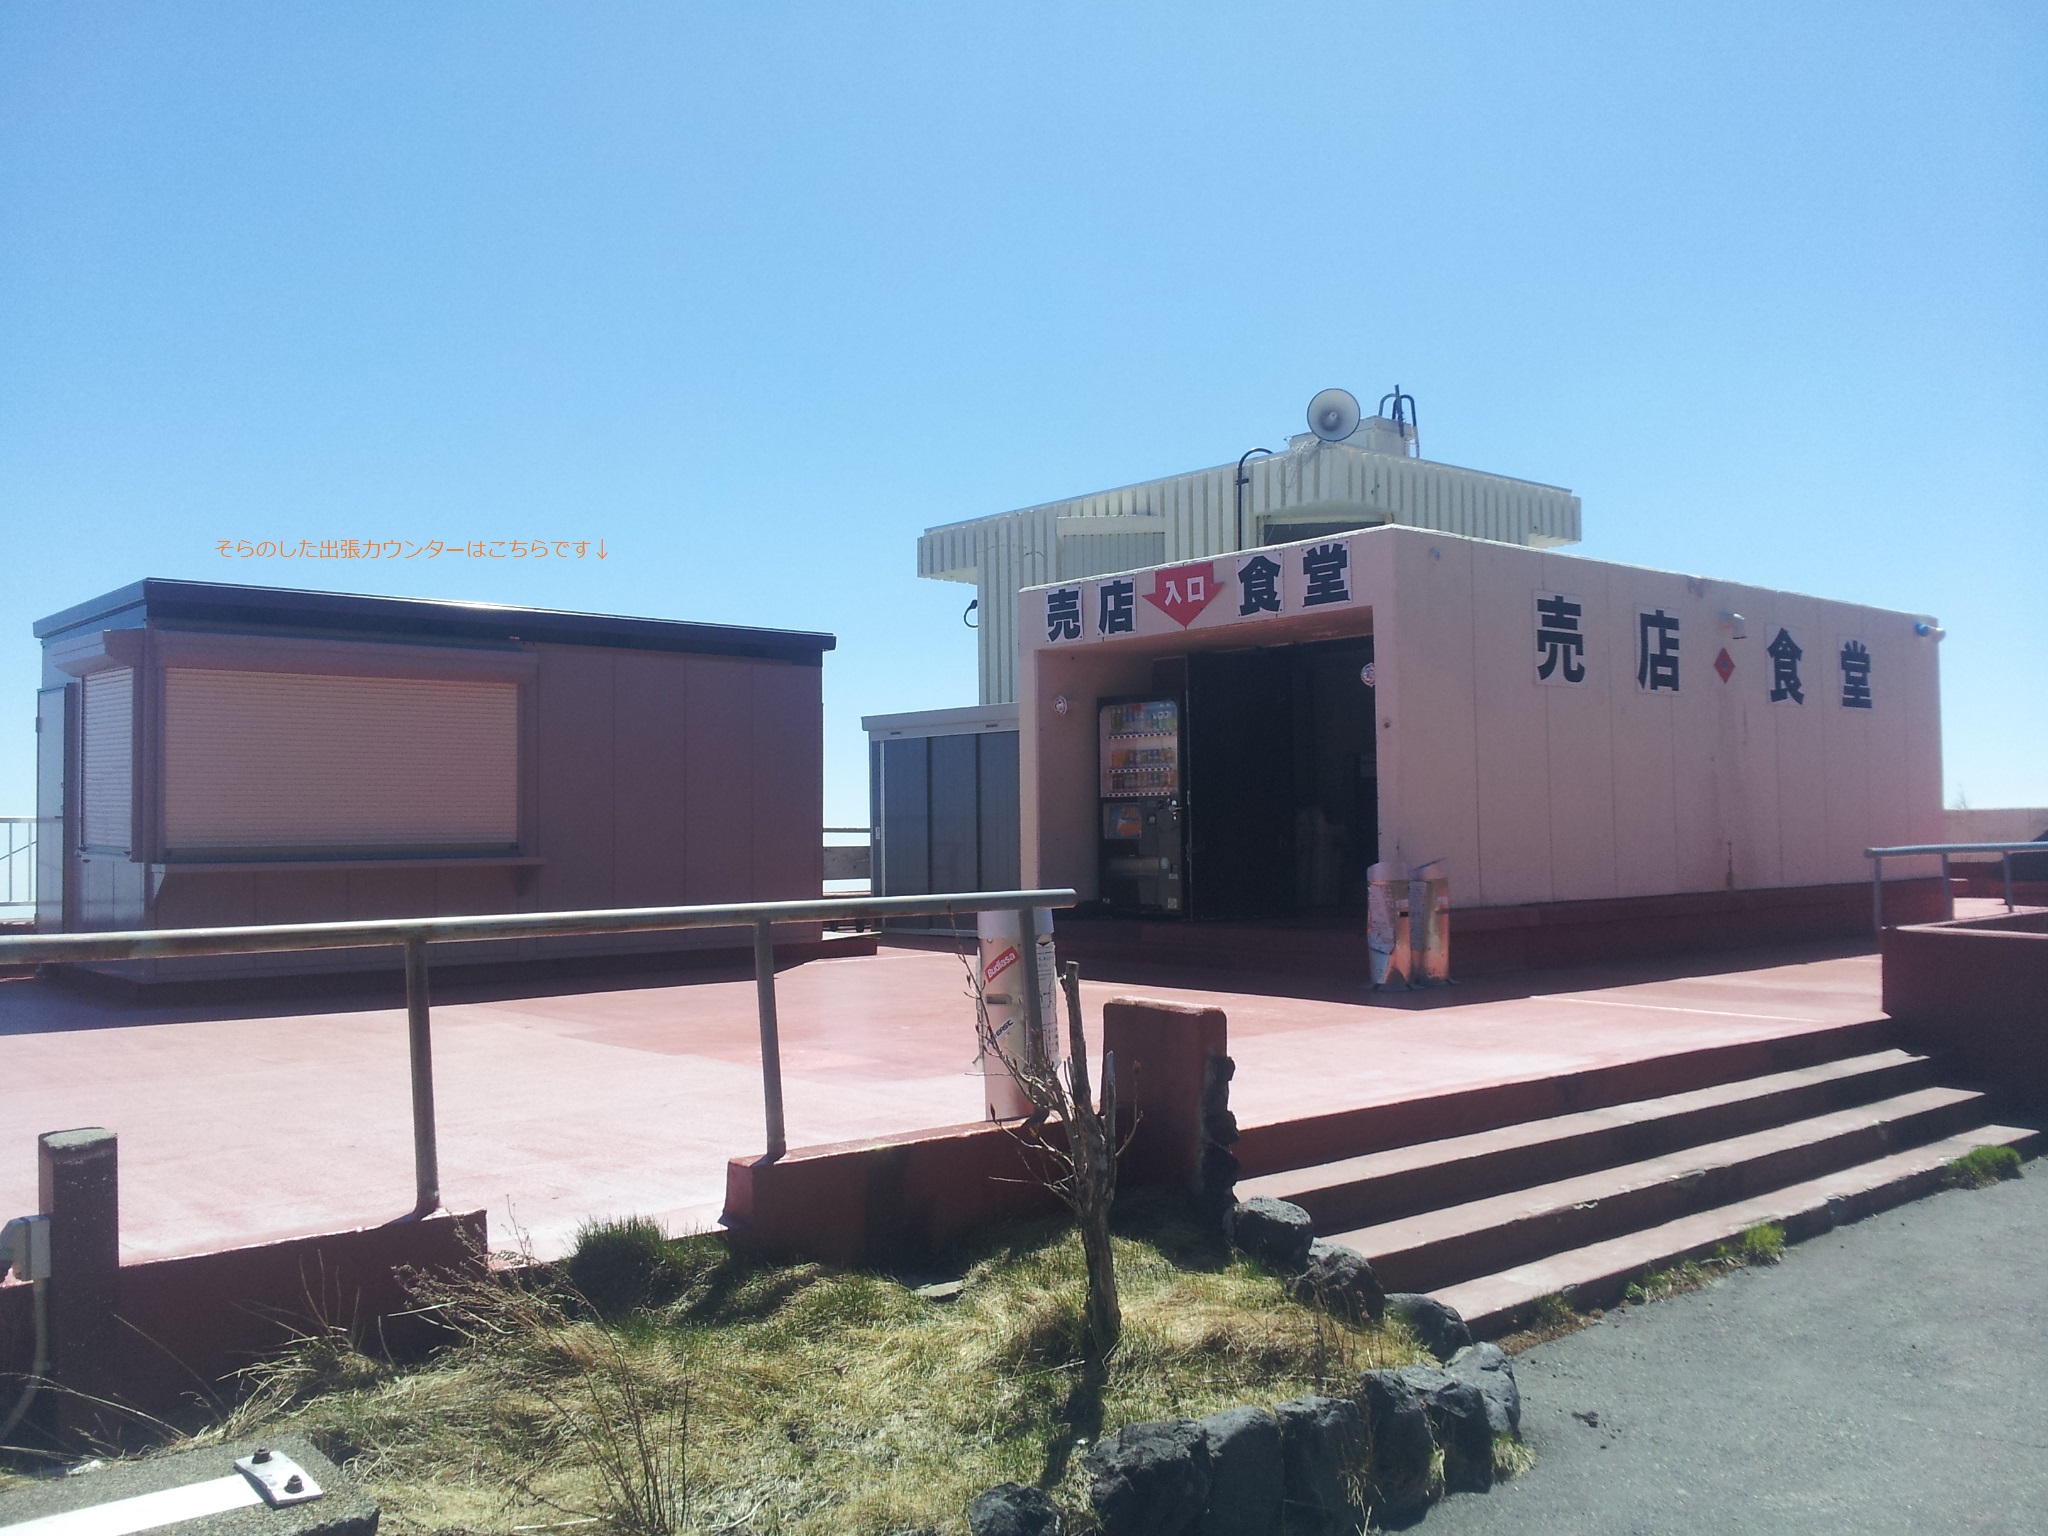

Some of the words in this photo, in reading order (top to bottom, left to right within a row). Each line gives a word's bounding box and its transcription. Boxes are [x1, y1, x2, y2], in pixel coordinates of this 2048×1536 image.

[1046, 580, 1135, 642] 売店
[1164, 576, 1205, 606] 入口
[1237, 543, 1350, 617] 食堂
